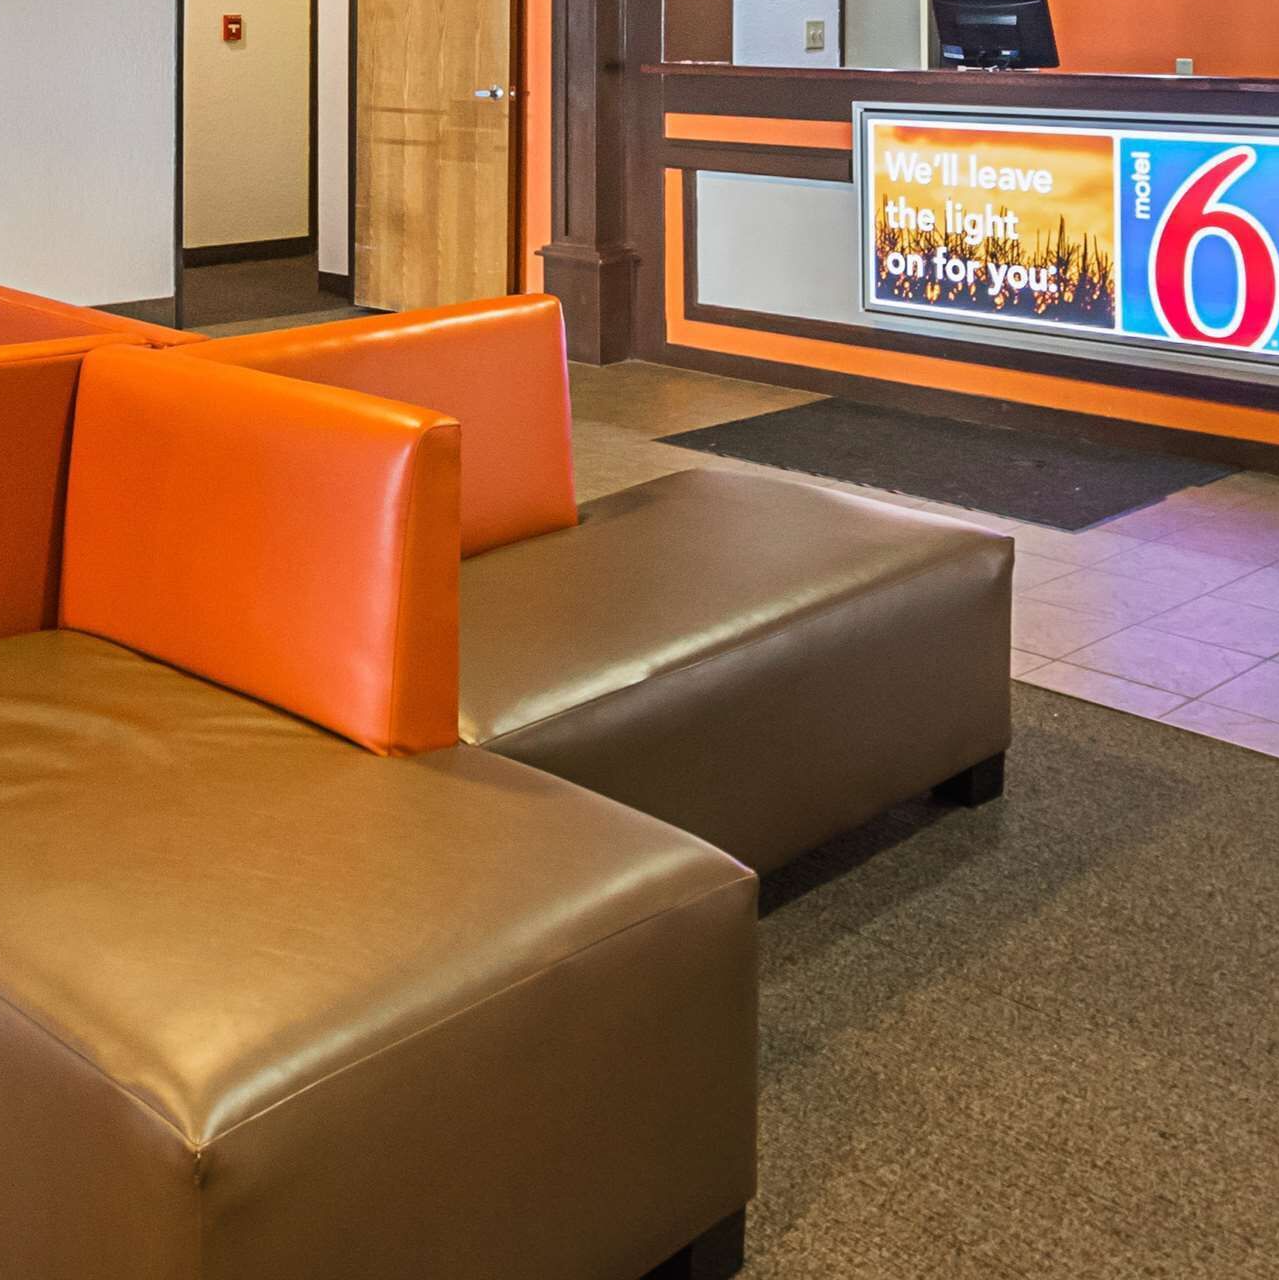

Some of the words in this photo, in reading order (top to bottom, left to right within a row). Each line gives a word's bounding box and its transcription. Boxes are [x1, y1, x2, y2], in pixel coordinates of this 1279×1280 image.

[884, 151, 958, 187] We'll
[970, 154, 1053, 194] leave
[1130, 151, 1151, 220] motel
[886, 196, 935, 232] the
[945, 200, 1019, 245] light
[886, 251, 924, 278] on
[934, 246, 980, 283] for
